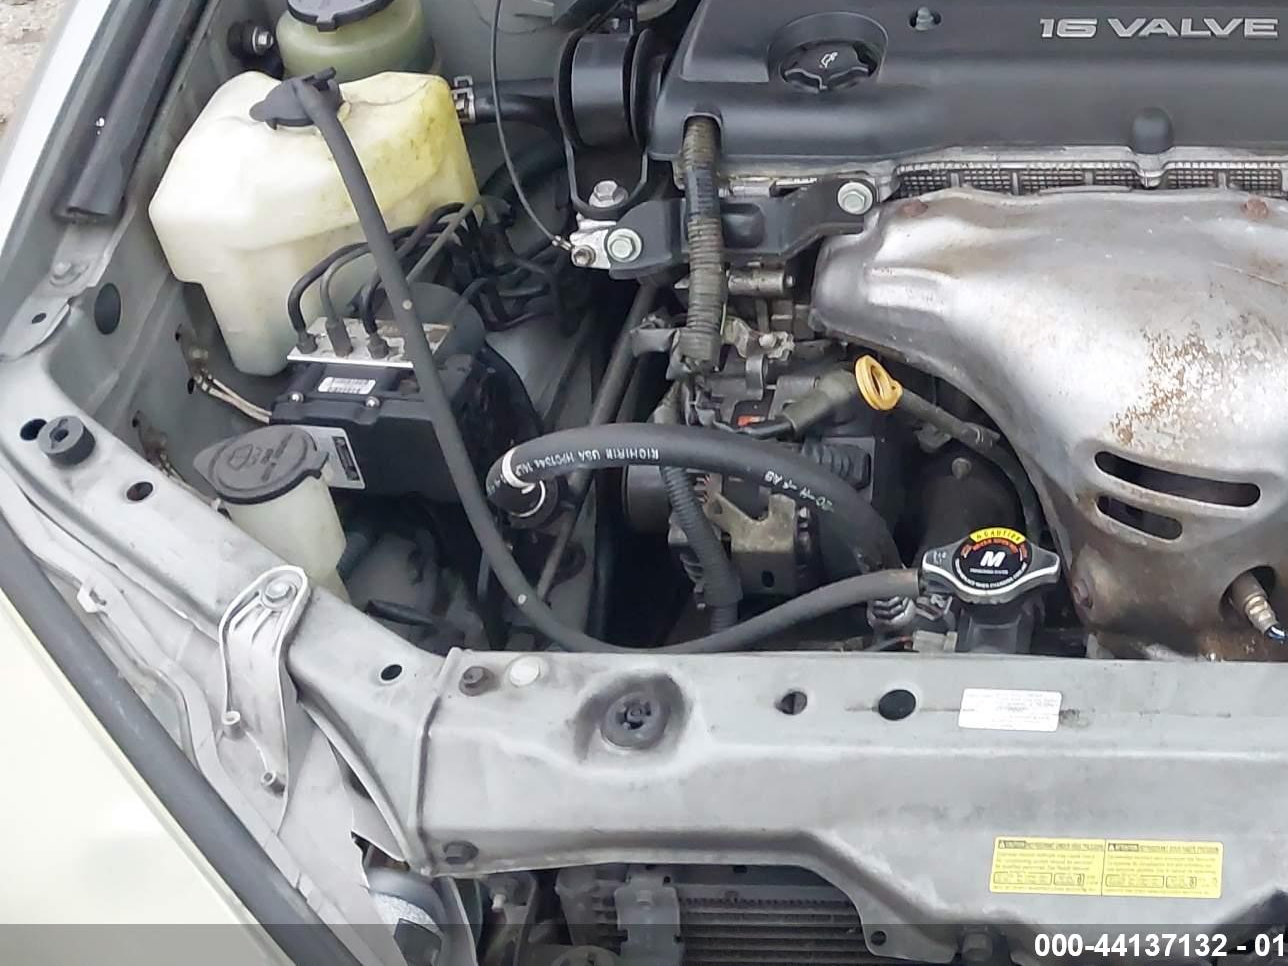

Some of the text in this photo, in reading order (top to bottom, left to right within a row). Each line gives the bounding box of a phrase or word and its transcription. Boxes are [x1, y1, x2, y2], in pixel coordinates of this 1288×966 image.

[1040, 18, 1279, 39] 16 VALVE
[980, 550, 1006, 568] M
